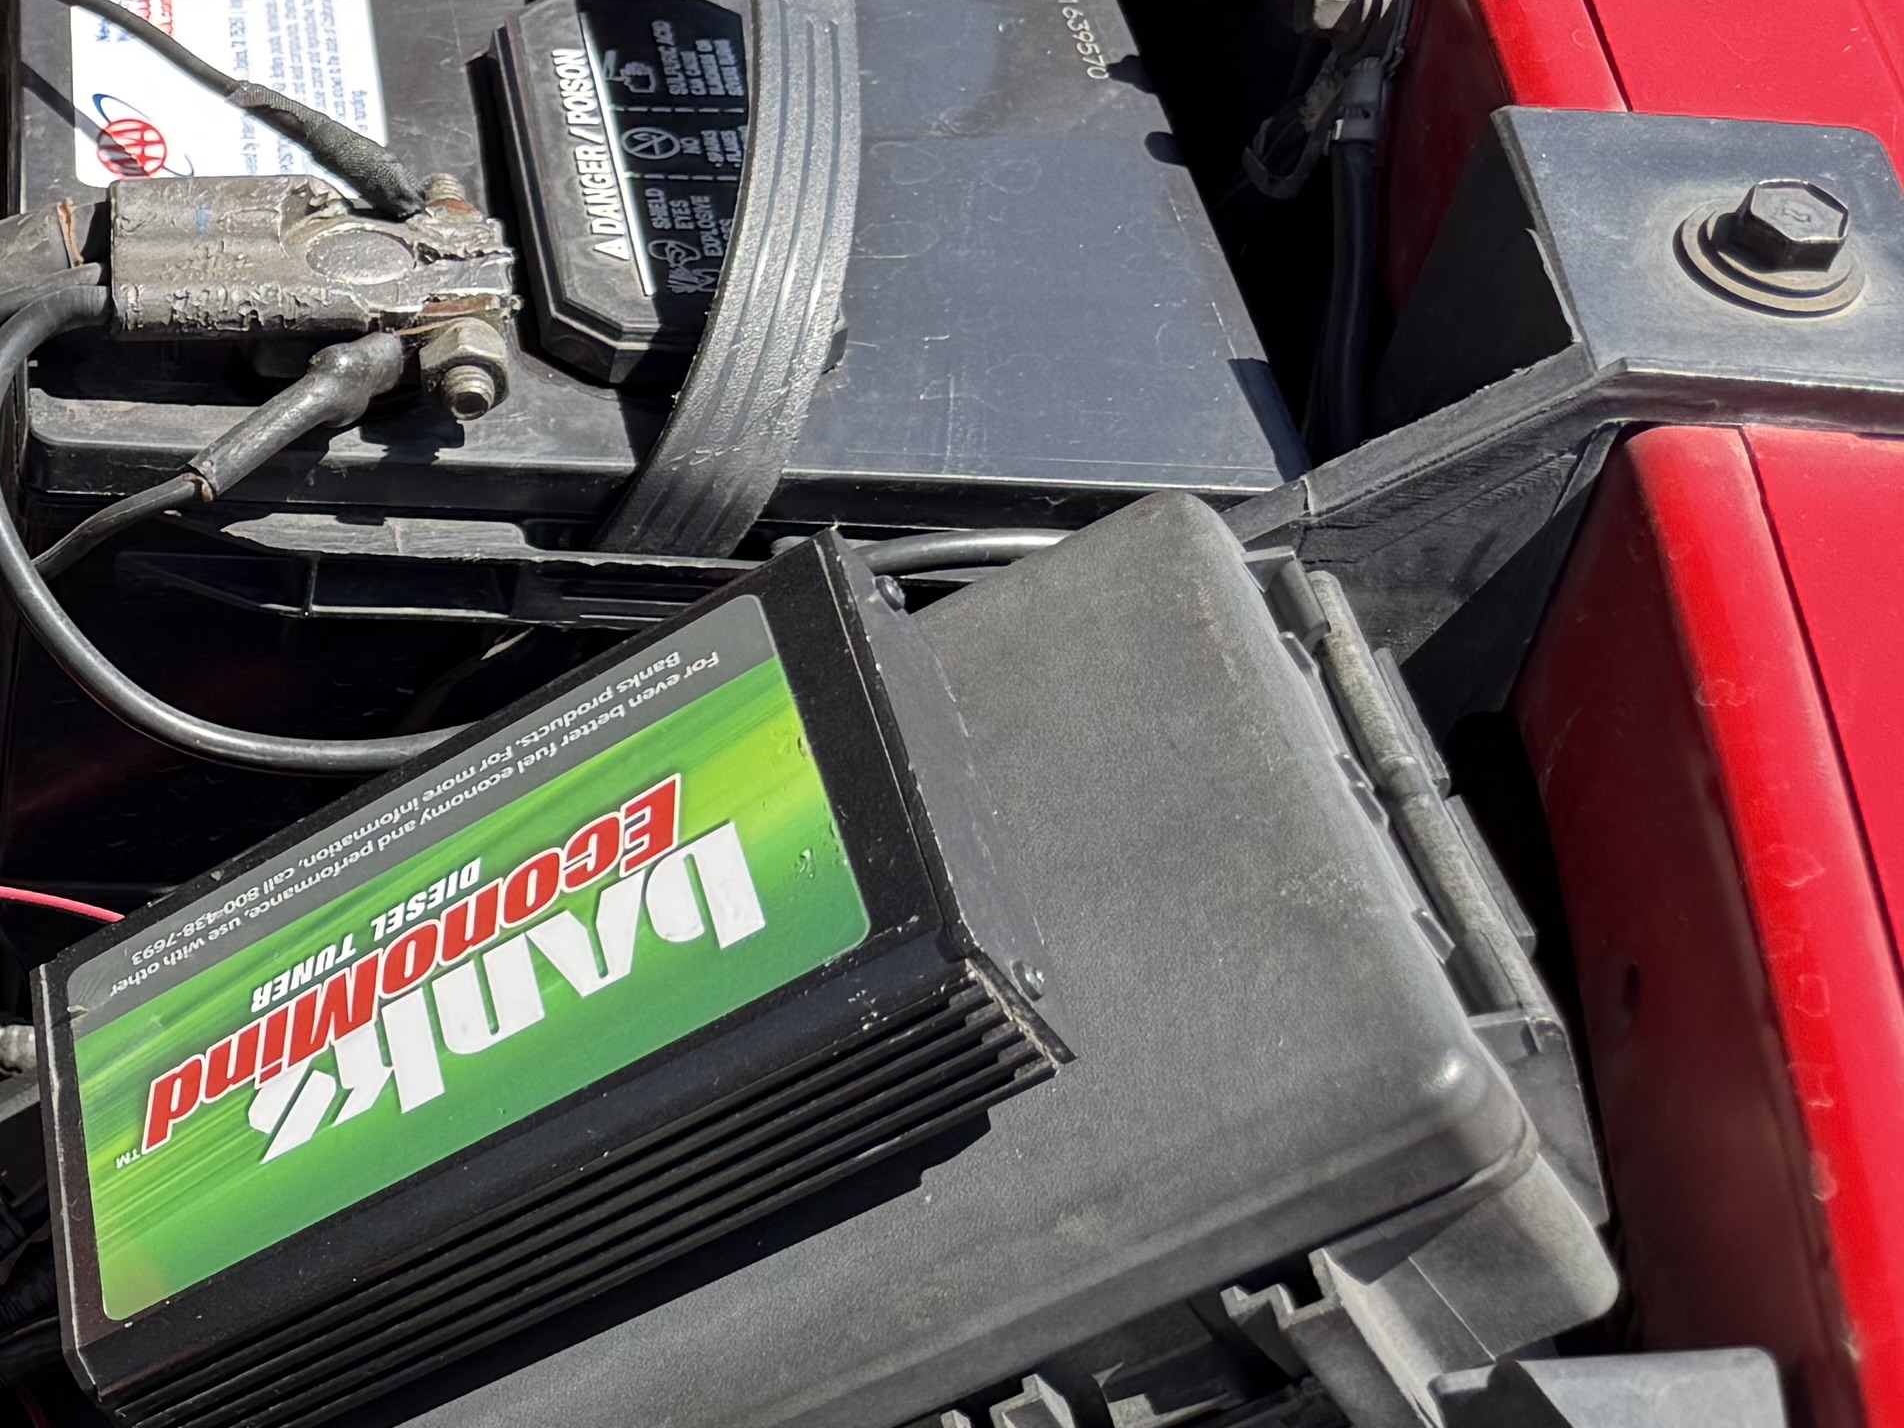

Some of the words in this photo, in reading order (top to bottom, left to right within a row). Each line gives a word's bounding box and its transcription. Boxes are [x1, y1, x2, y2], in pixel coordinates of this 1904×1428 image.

[679, 136, 702, 154] NO
[643, 188, 673, 228] SHIELD
[669, 199, 695, 229] EYES
[689, 195, 725, 256] EXPLOSIVE
[615, 649, 681, 697] Banks
[680, 649, 719, 683] For
[625, 670, 681, 710] even
[513, 684, 615, 754] products.
[558, 701, 626, 752] better
[476, 744, 513, 776] For
[516, 739, 558, 775] fuel
[417, 760, 514, 826] economy
[420, 763, 475, 804] more
[297, 794, 420, 875] information,
[375, 816, 417, 853] and
[242, 837, 374, 925] performance,
[260, 864, 295, 896] call
[370, 855, 480, 942] DIESEL
[129, 882, 259, 968] 800-438-7693
[207, 912, 241, 942] use
[142, 771, 680, 1156] EconoMind
[162, 933, 205, 970] with
[251, 931, 356, 1013] TUNER
[108, 958, 159, 1000] other
[247, 819, 766, 1165] banks
